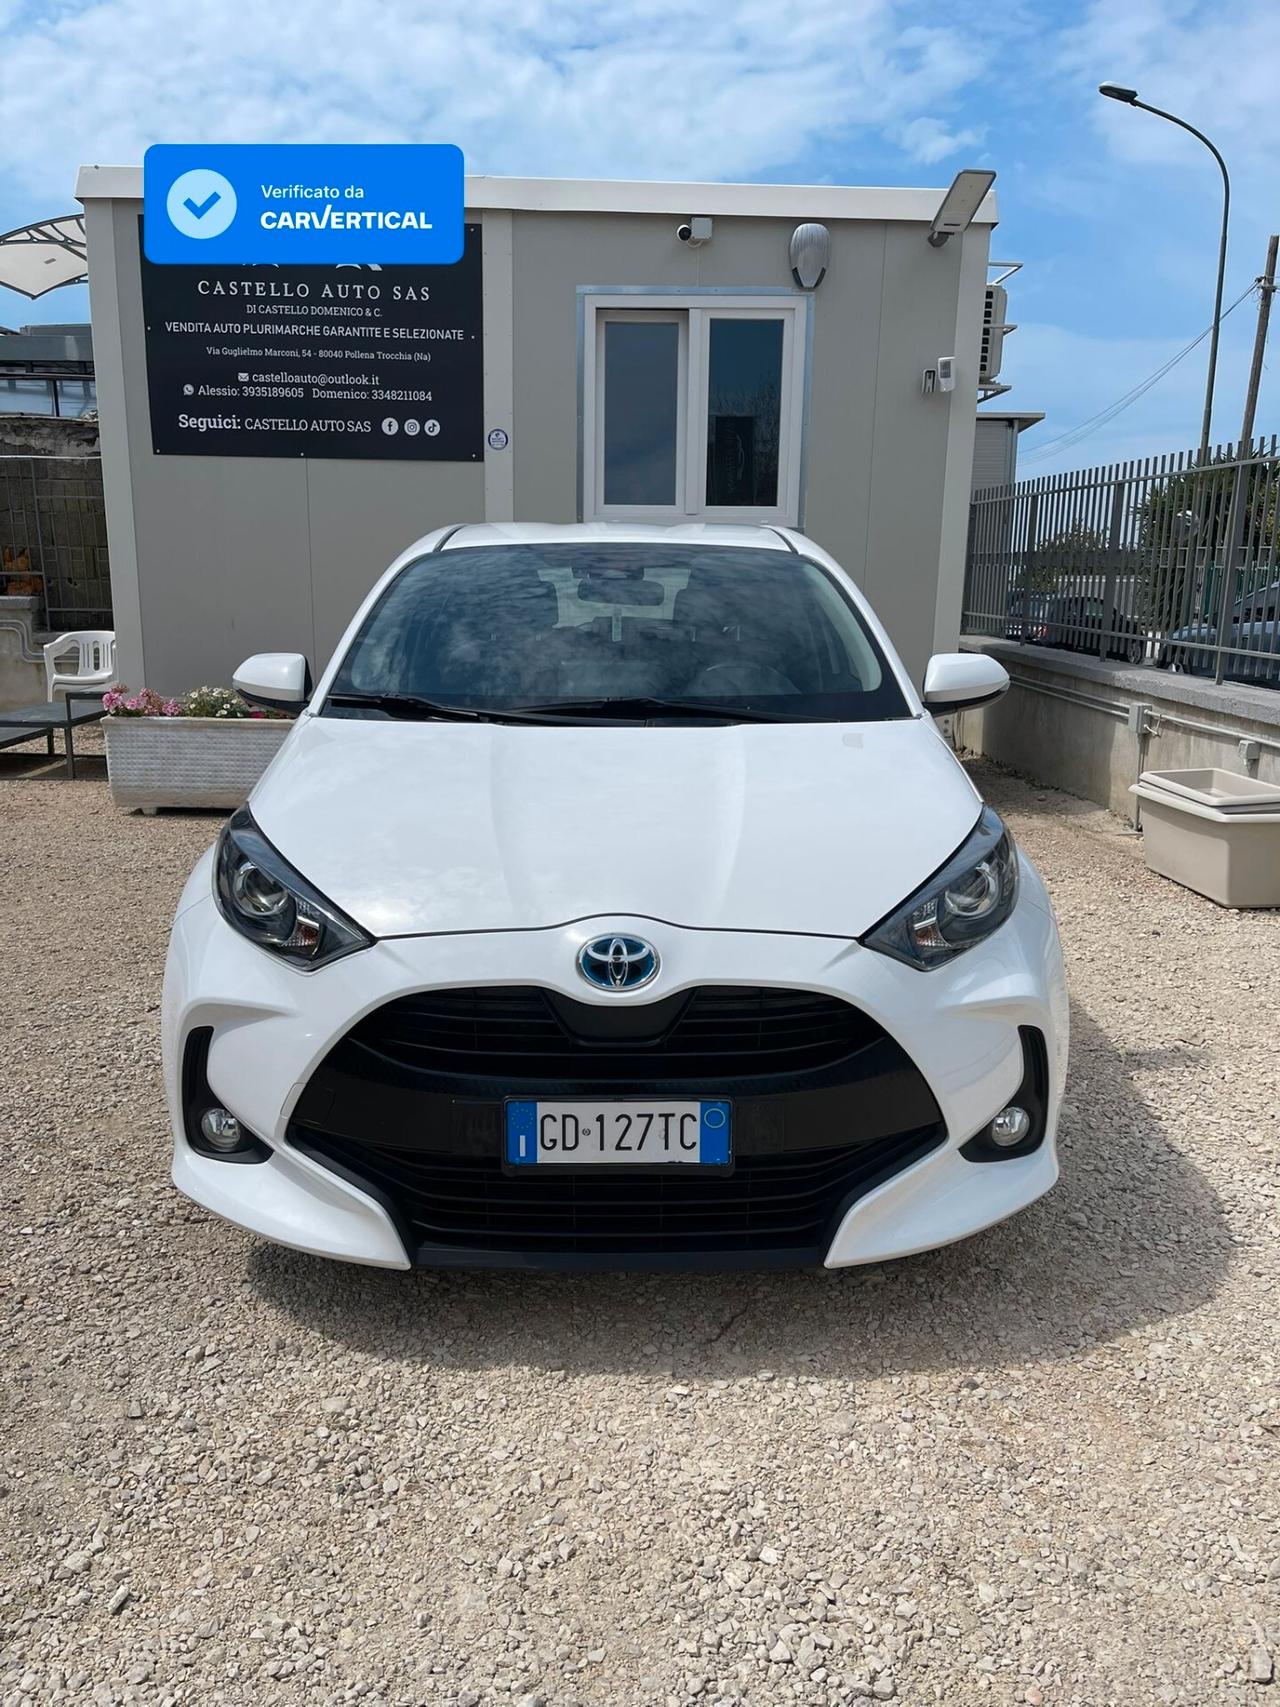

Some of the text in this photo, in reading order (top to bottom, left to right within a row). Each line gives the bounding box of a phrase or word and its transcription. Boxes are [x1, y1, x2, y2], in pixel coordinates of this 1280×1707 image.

[197, 280, 431, 302] CASTELLO AUTO SAS
[246, 304, 382, 318] DI CASTELLO DOMENICO & C.
[165, 322, 465, 341] VENDITA AUTO PLURIMARCHE GARANTITE E SELEZIONATE
[206, 346, 220, 356] Via
[221, 347, 263, 358] Guglielmo
[264, 348, 301, 358] Marconi,
[302, 348, 312, 358] 54
[318, 349, 344, 359] 80040
[345, 350, 375, 360] Pollena
[376, 351, 412, 361] Trocchia
[413, 352, 431, 362] (Na)
[252, 371, 380, 386] castelloauto@outlook.it
[198, 385, 433, 402] Alessio: 3935189605 Domenico: 3348211084
[178, 414, 372, 433] Seguici: CASTELLO AUTO SAS
